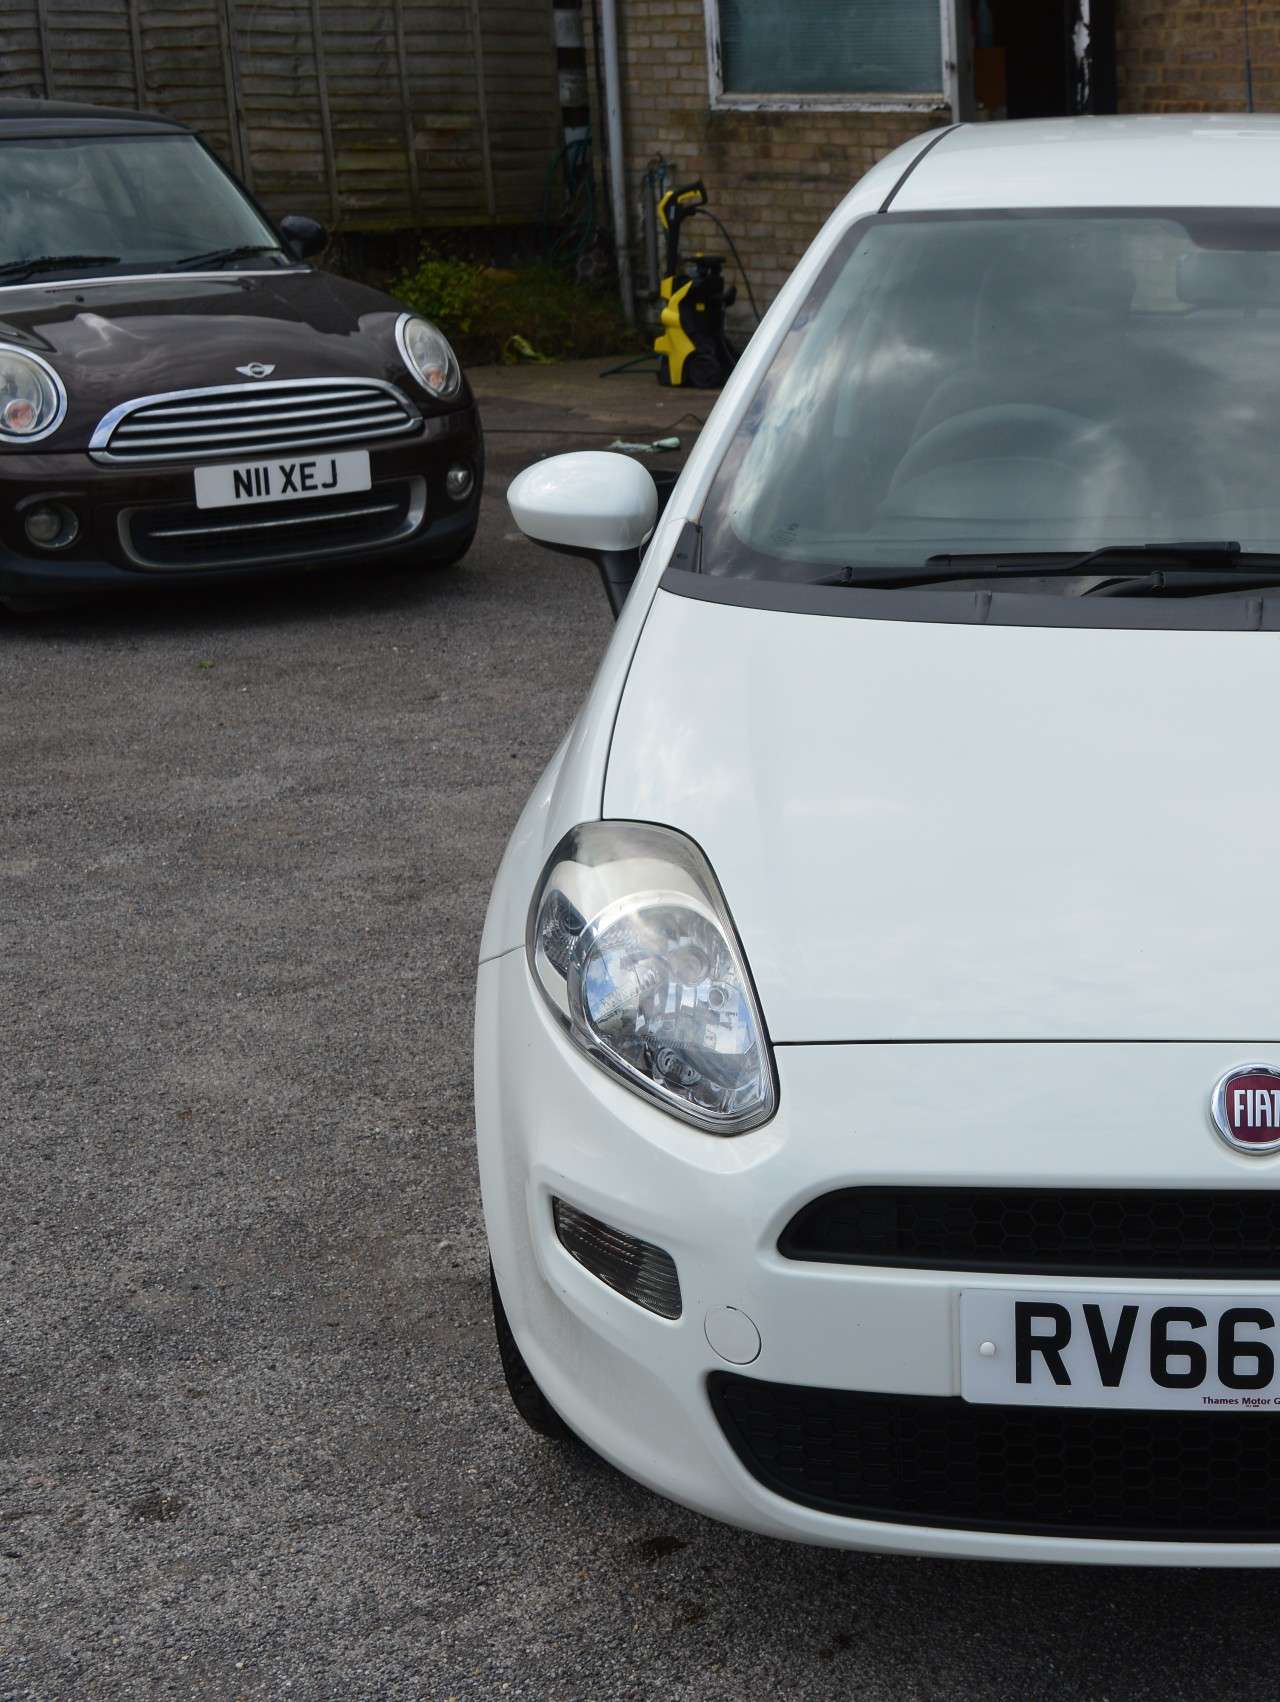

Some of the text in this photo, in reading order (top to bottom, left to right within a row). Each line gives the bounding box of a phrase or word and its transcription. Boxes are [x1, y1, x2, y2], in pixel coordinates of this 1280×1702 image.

[279, 459, 338, 494] XEJ
[1014, 1301, 1276, 1390] RV66
[1202, 1396, 1239, 1405] Thames
[1241, 1397, 1270, 1405] Motor
